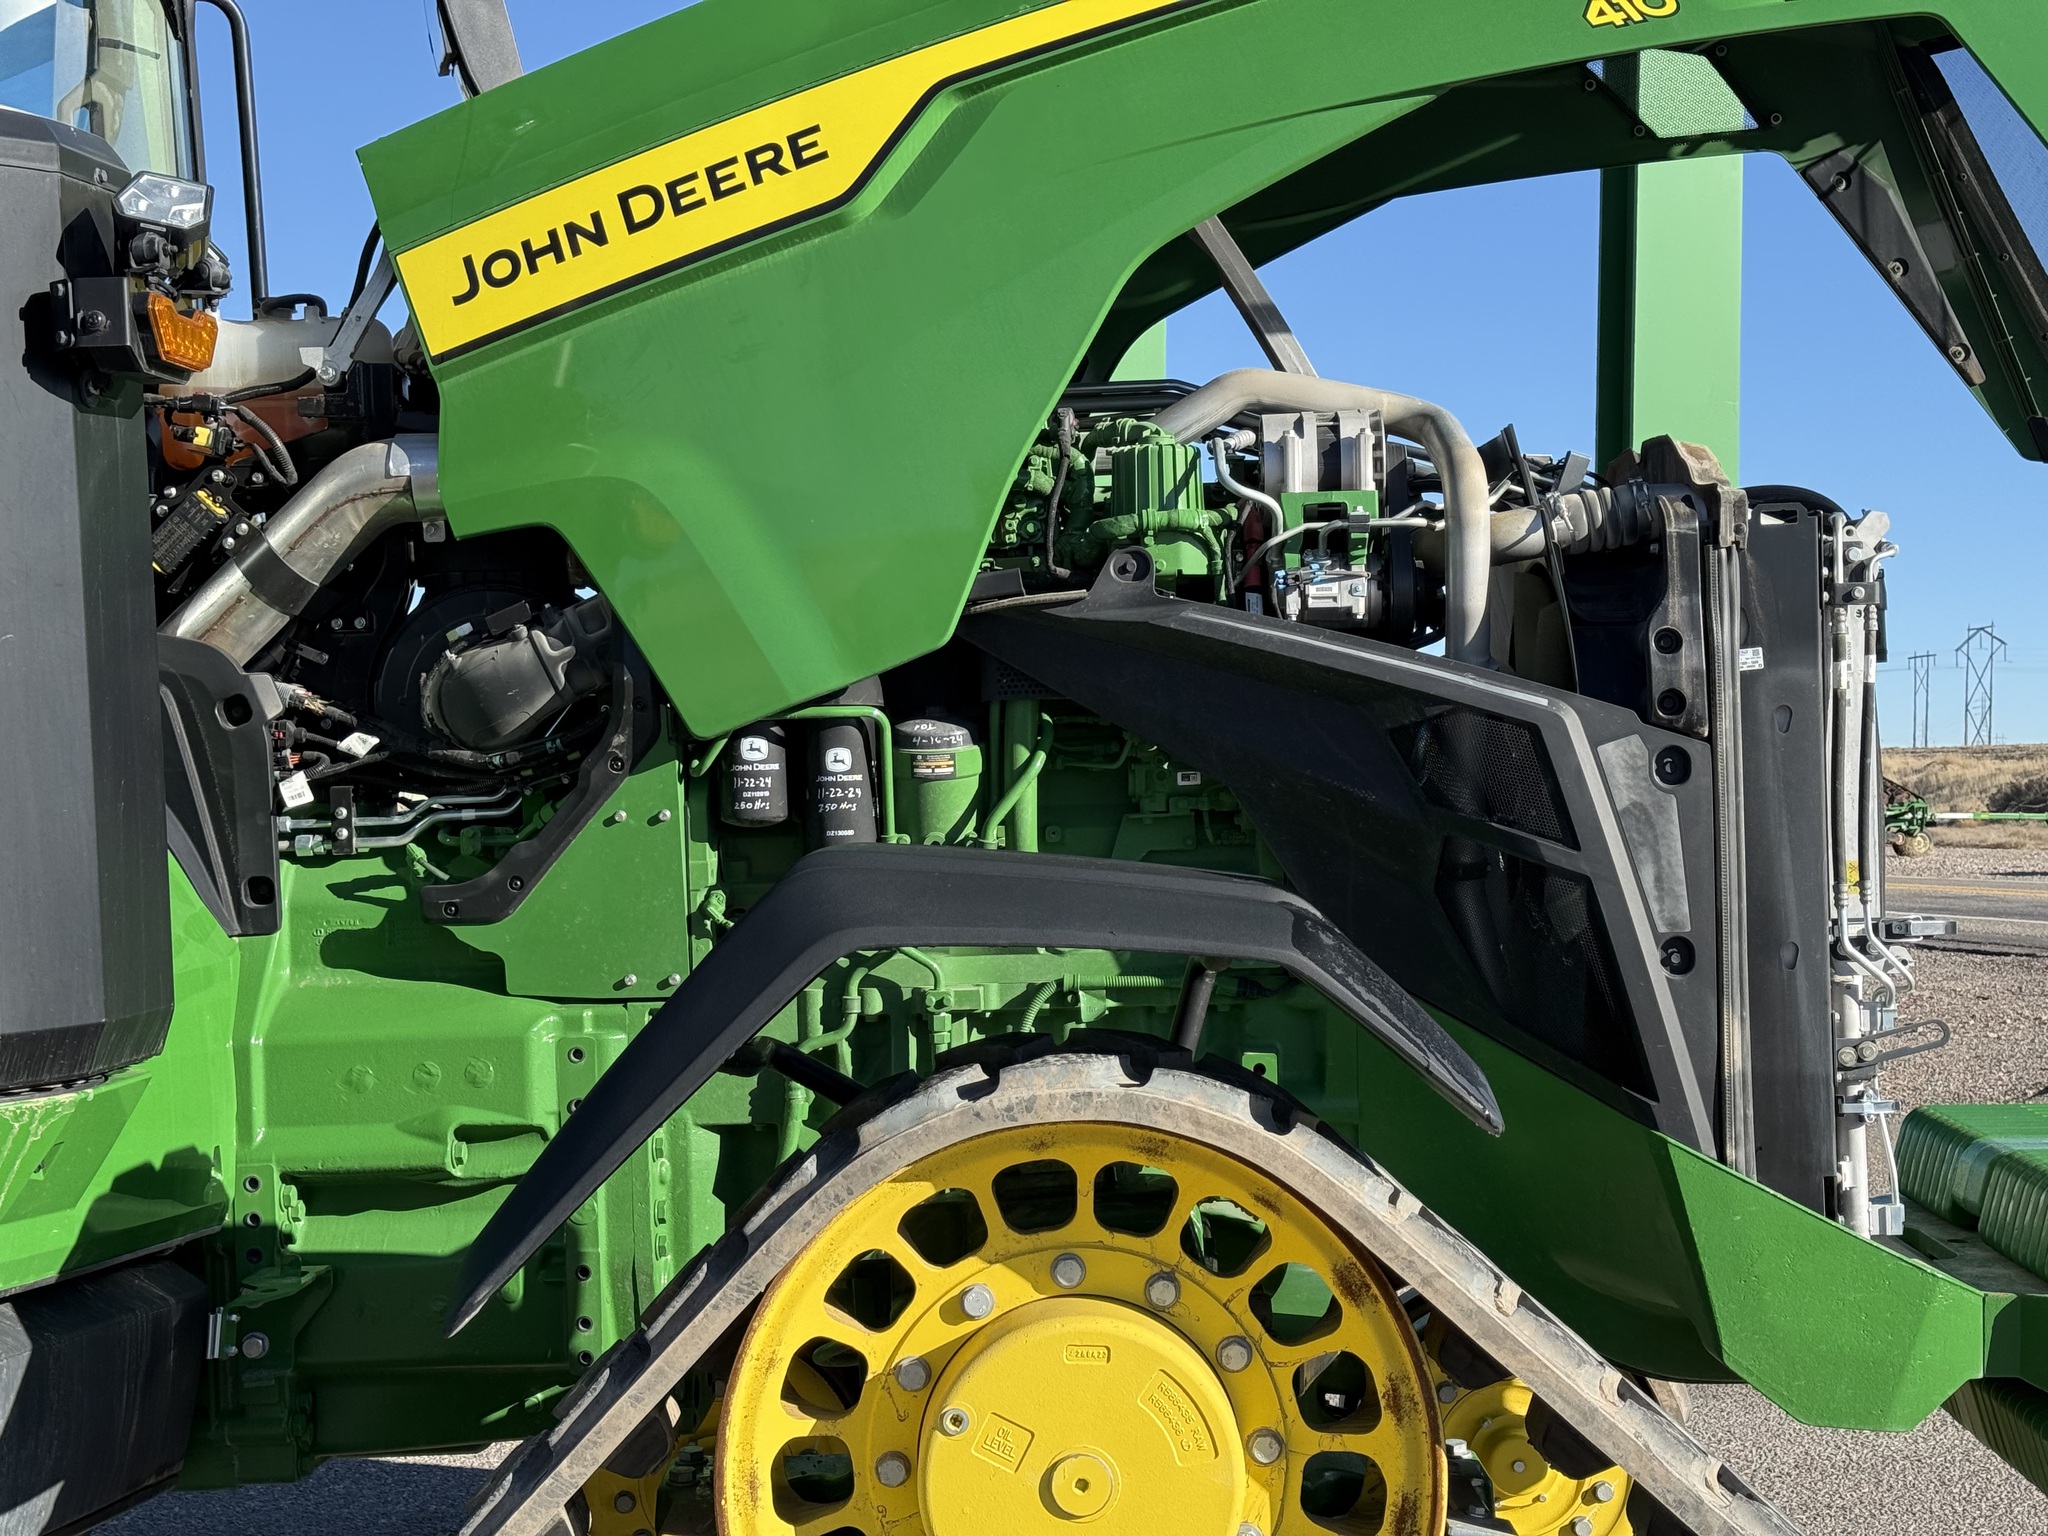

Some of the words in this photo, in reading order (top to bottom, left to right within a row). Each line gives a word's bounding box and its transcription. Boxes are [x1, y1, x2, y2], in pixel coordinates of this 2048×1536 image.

[452, 210, 609, 306] JOHN
[616, 123, 829, 235] DEERE
[753, 763, 780, 771] DEERE
[733, 776, 772, 789] 11-22-24
[837, 774, 863, 782] DEERE
[817, 787, 862, 799] 11-22-24
[734, 801, 753, 810] 250
[754, 798, 770, 810] Hrs
[818, 803, 837, 813] 250
[839, 800, 857, 811] Hrs
[997, 1426, 1012, 1443] OIL
[1191, 1426, 1207, 1451] RAW
[984, 1434, 1015, 1458] LEVEL
